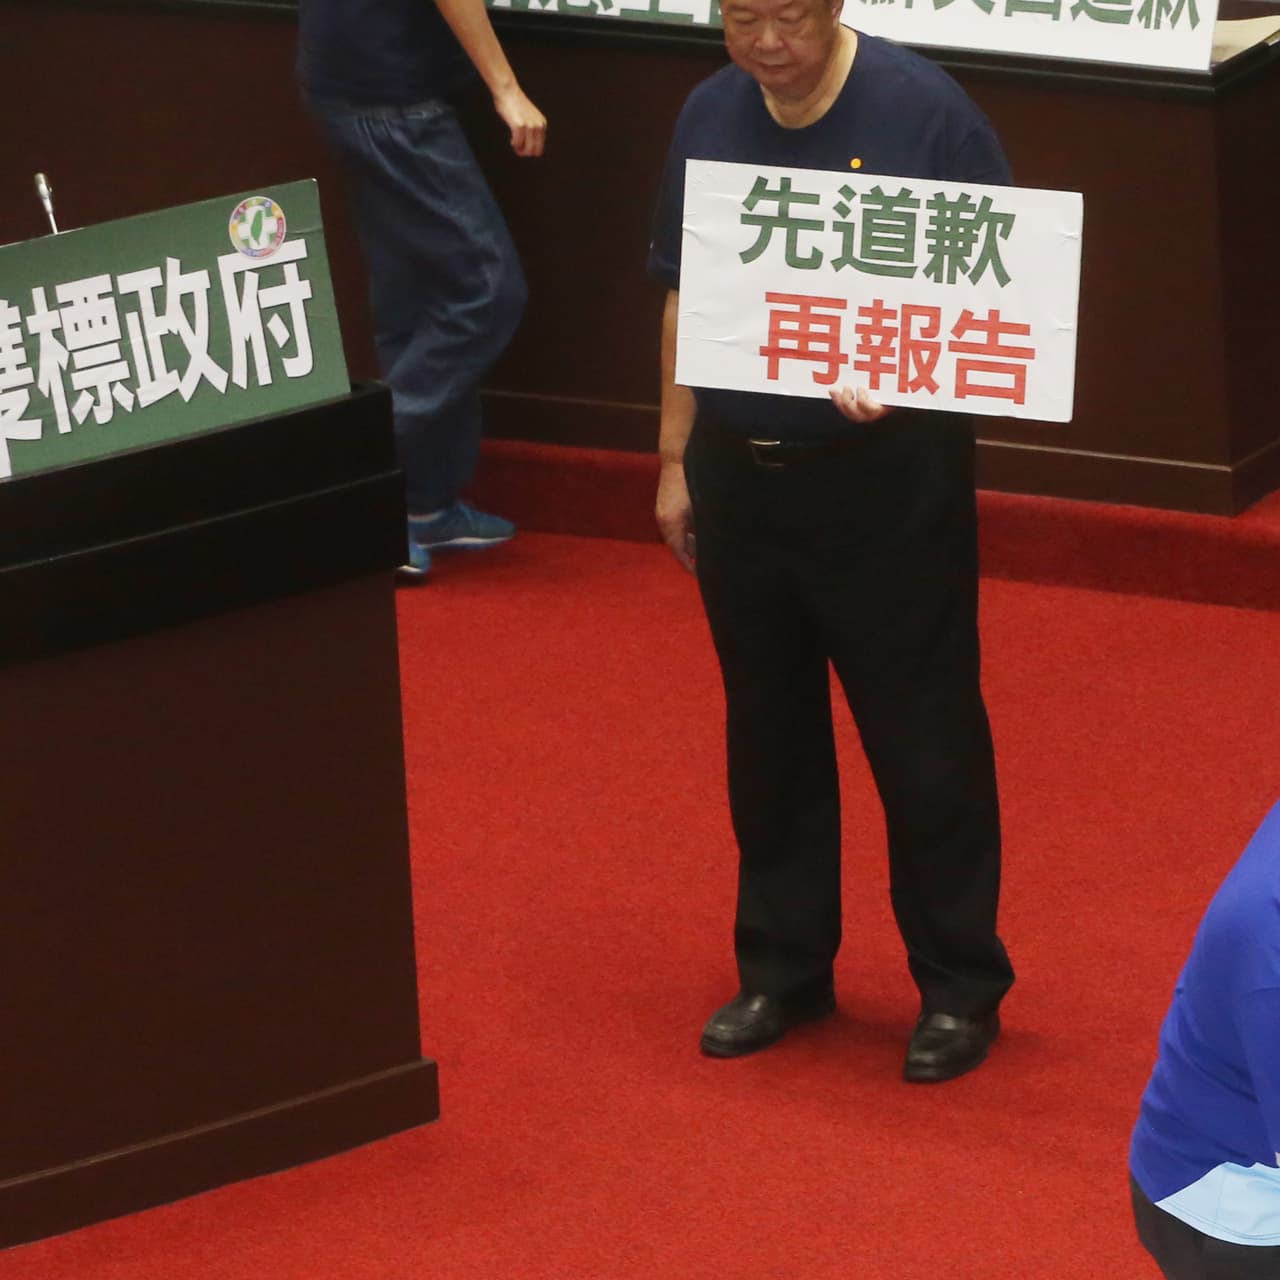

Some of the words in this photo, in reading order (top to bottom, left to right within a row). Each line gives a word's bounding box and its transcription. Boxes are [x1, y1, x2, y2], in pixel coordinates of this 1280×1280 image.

[739, 176, 1016, 288] 先道歉
[759, 292, 1037, 405] 再報告
